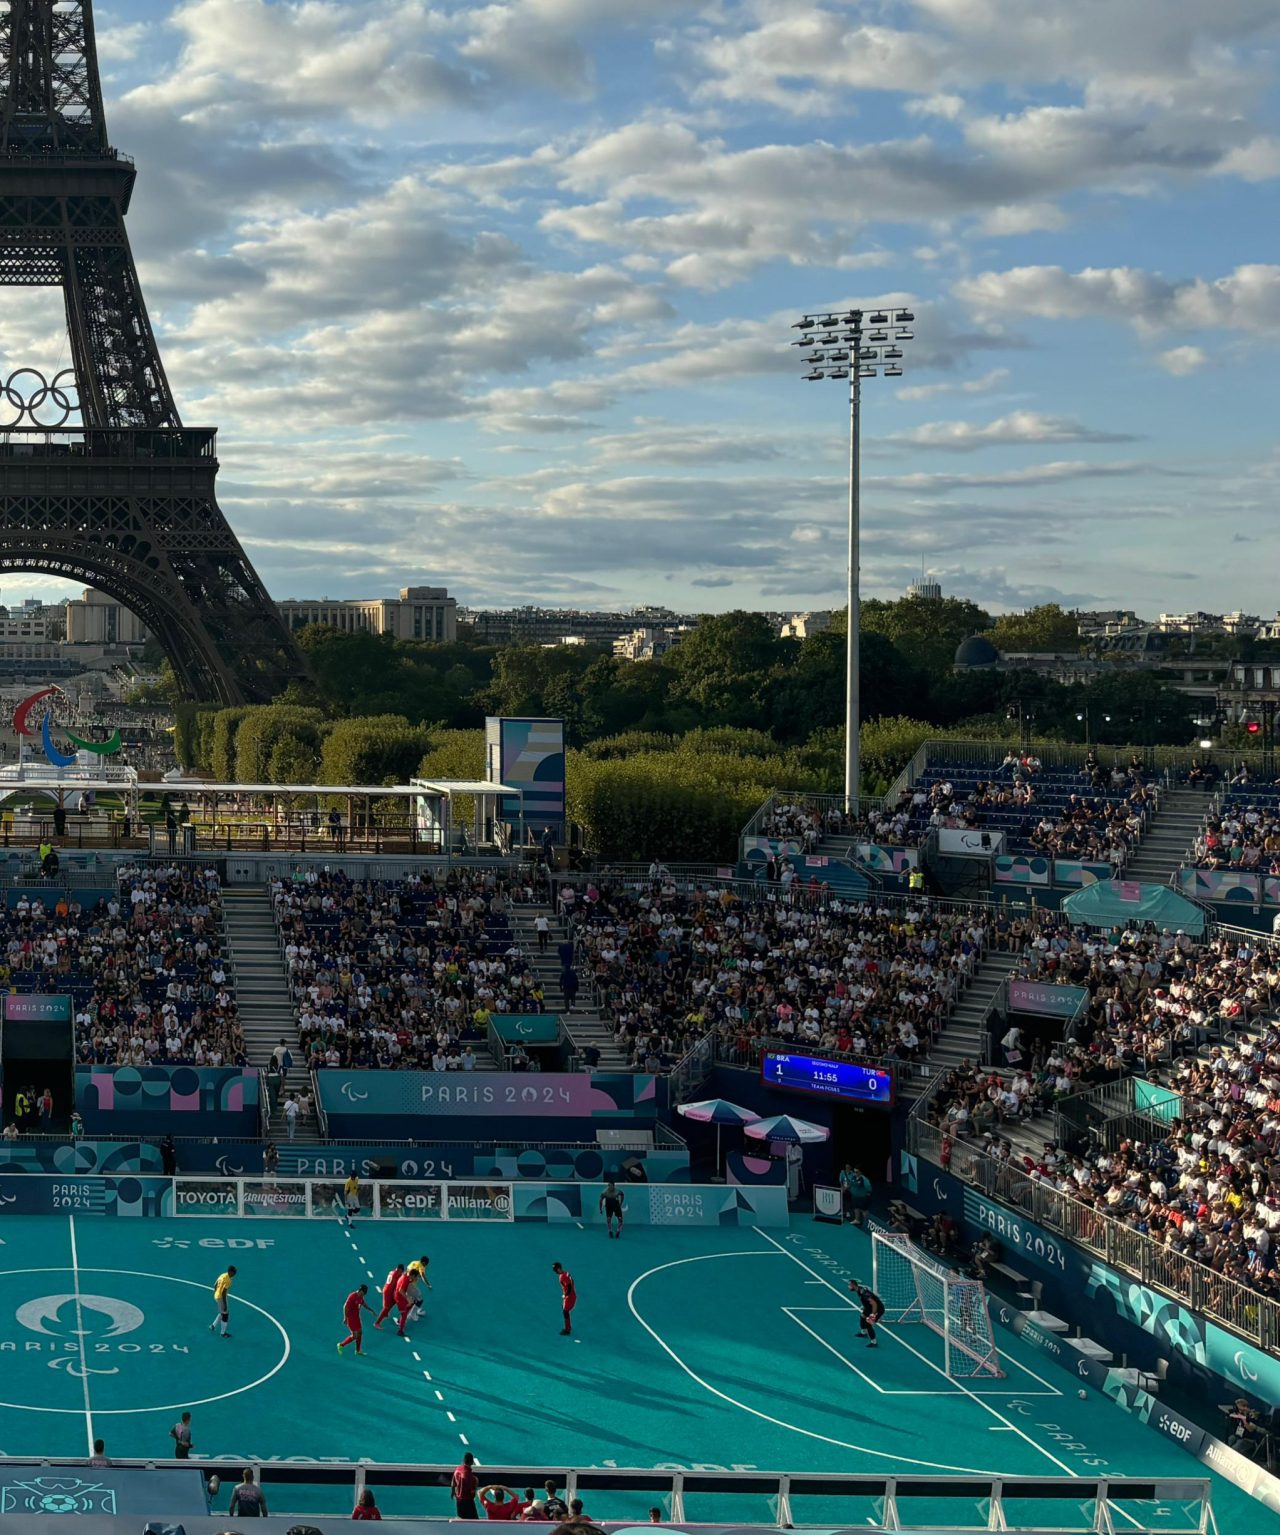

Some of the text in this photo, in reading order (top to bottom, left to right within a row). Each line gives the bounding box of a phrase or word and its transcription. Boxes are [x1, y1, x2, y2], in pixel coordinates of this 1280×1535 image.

[776, 1055, 876, 1076] BRA TUR
[776, 1064, 877, 1090] 1 11:55 0
[506, 1087, 570, 1102] 2024
[53, 1197, 90, 1207] 2024
[177, 1191, 236, 1204] TOYOTA
[448, 1196, 492, 1209] Allianz
[665, 1205, 703, 1217] 2024
[1026, 1232, 1065, 1270] 2024
[95, 1343, 189, 1354] 2024
